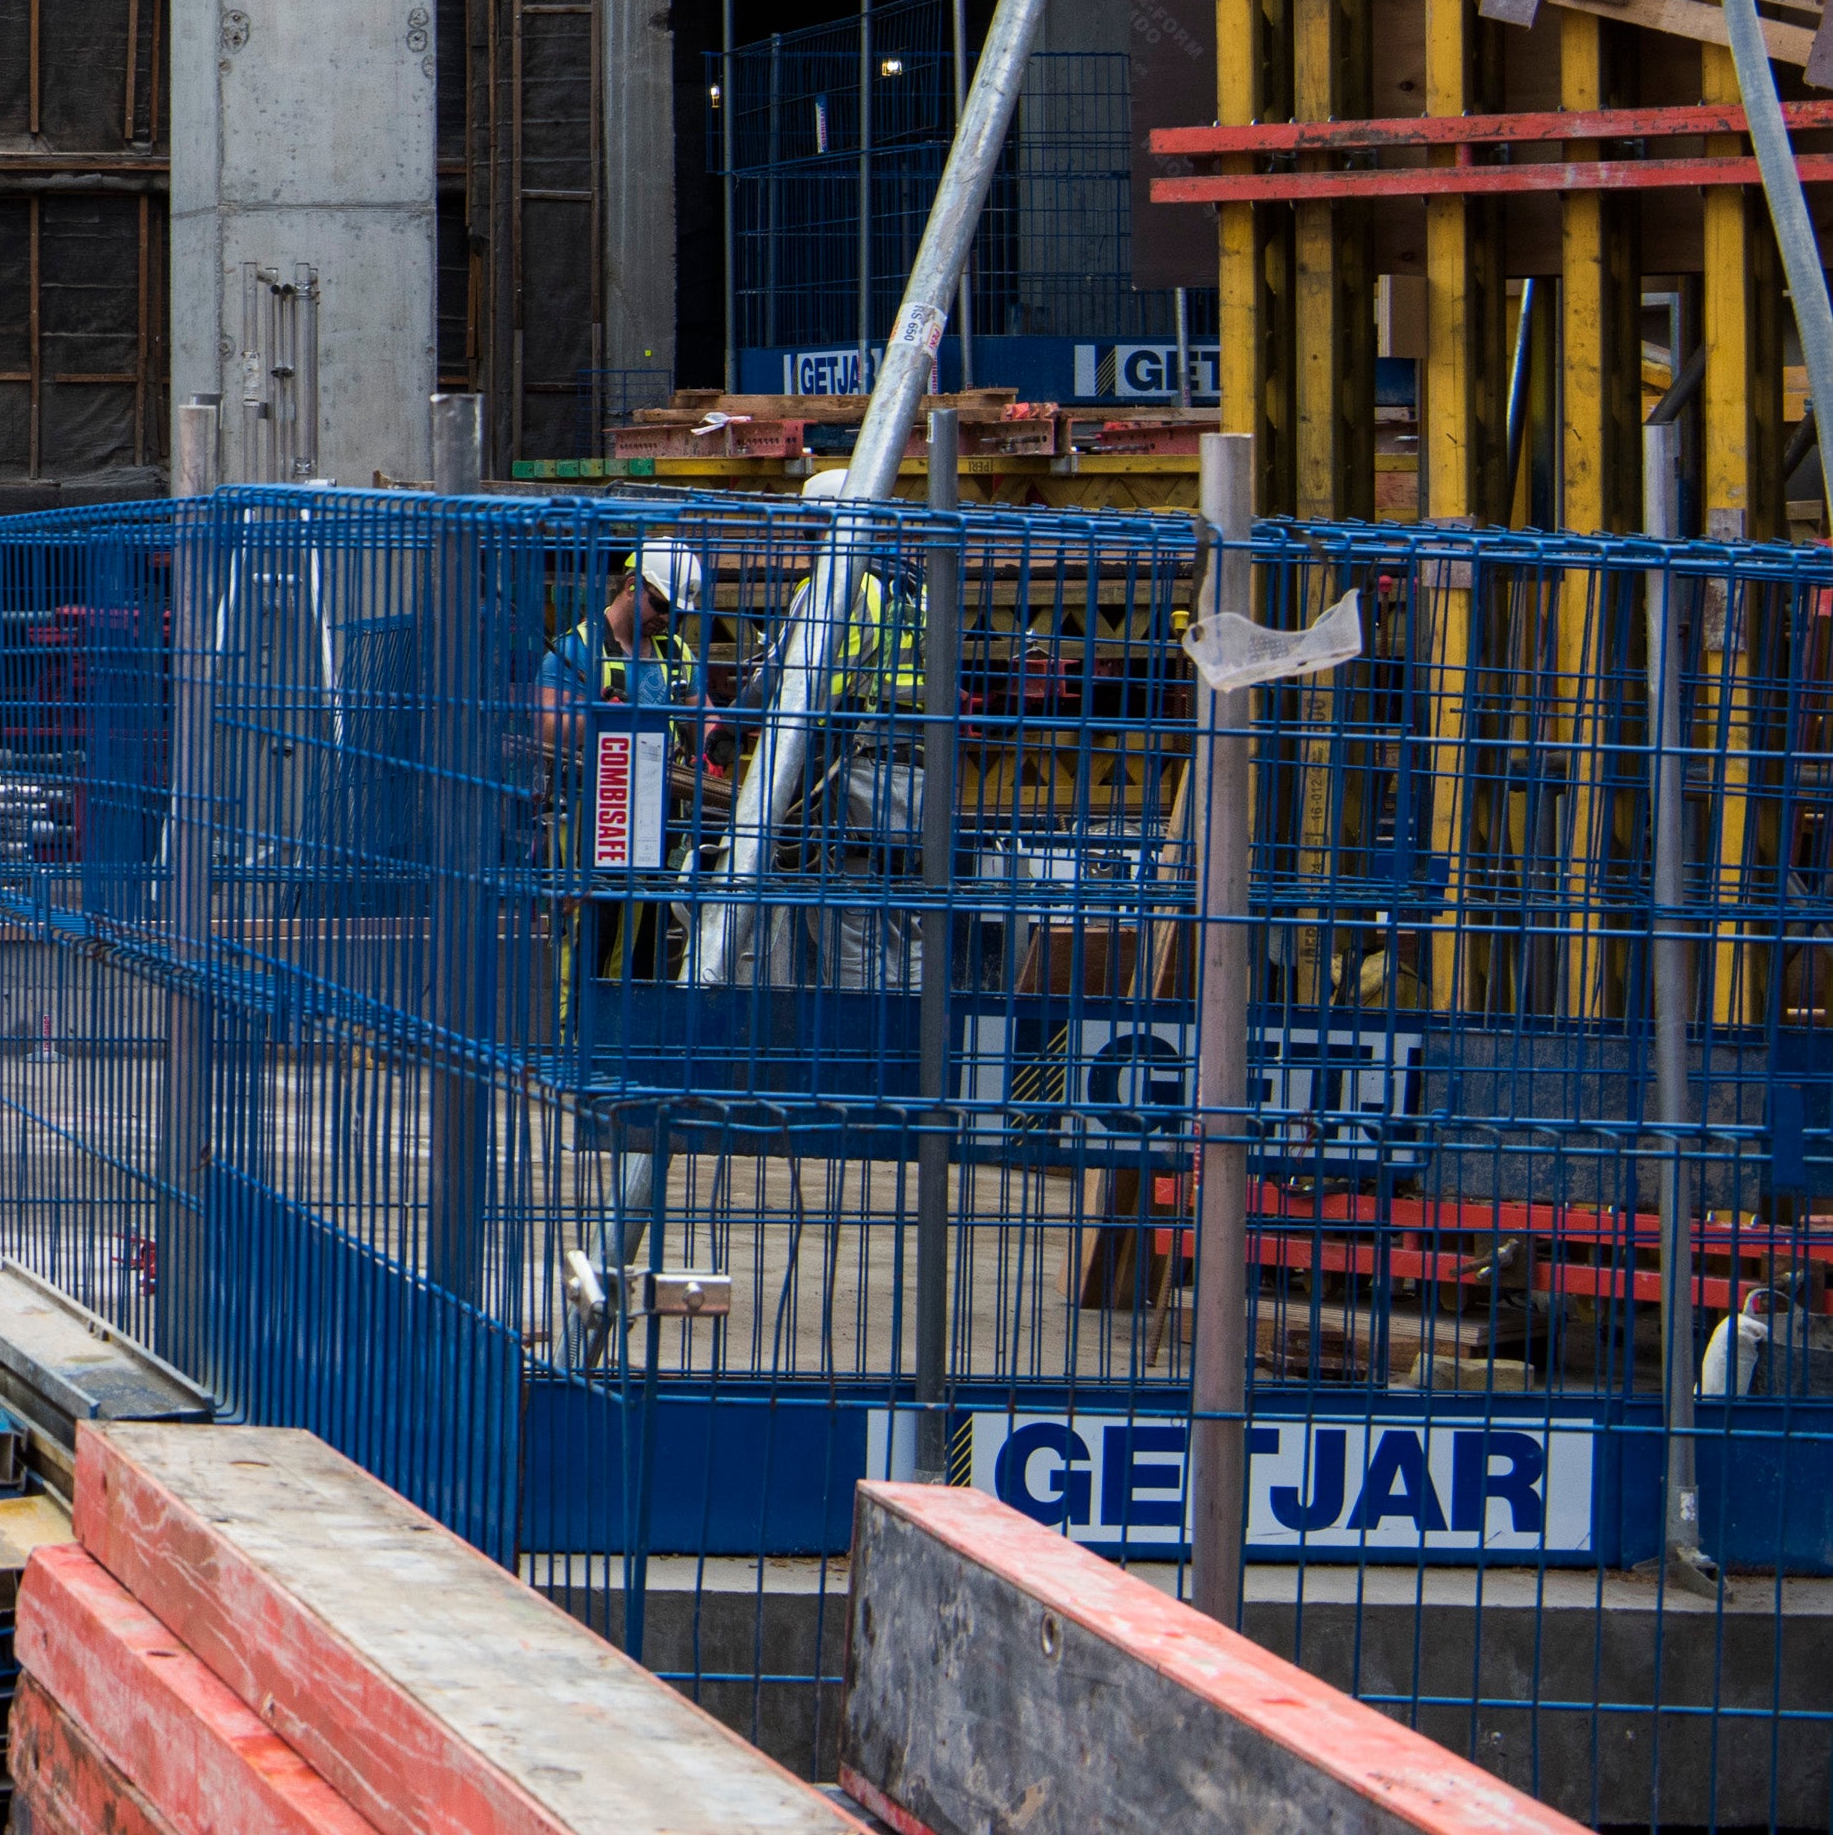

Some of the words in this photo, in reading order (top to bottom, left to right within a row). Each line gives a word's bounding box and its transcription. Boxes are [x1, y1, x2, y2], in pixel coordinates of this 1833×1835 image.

[904, 322, 919, 342] 650
[598, 737, 630, 862] COMBISAFE
[1310, 779, 1323, 821] 16-012
